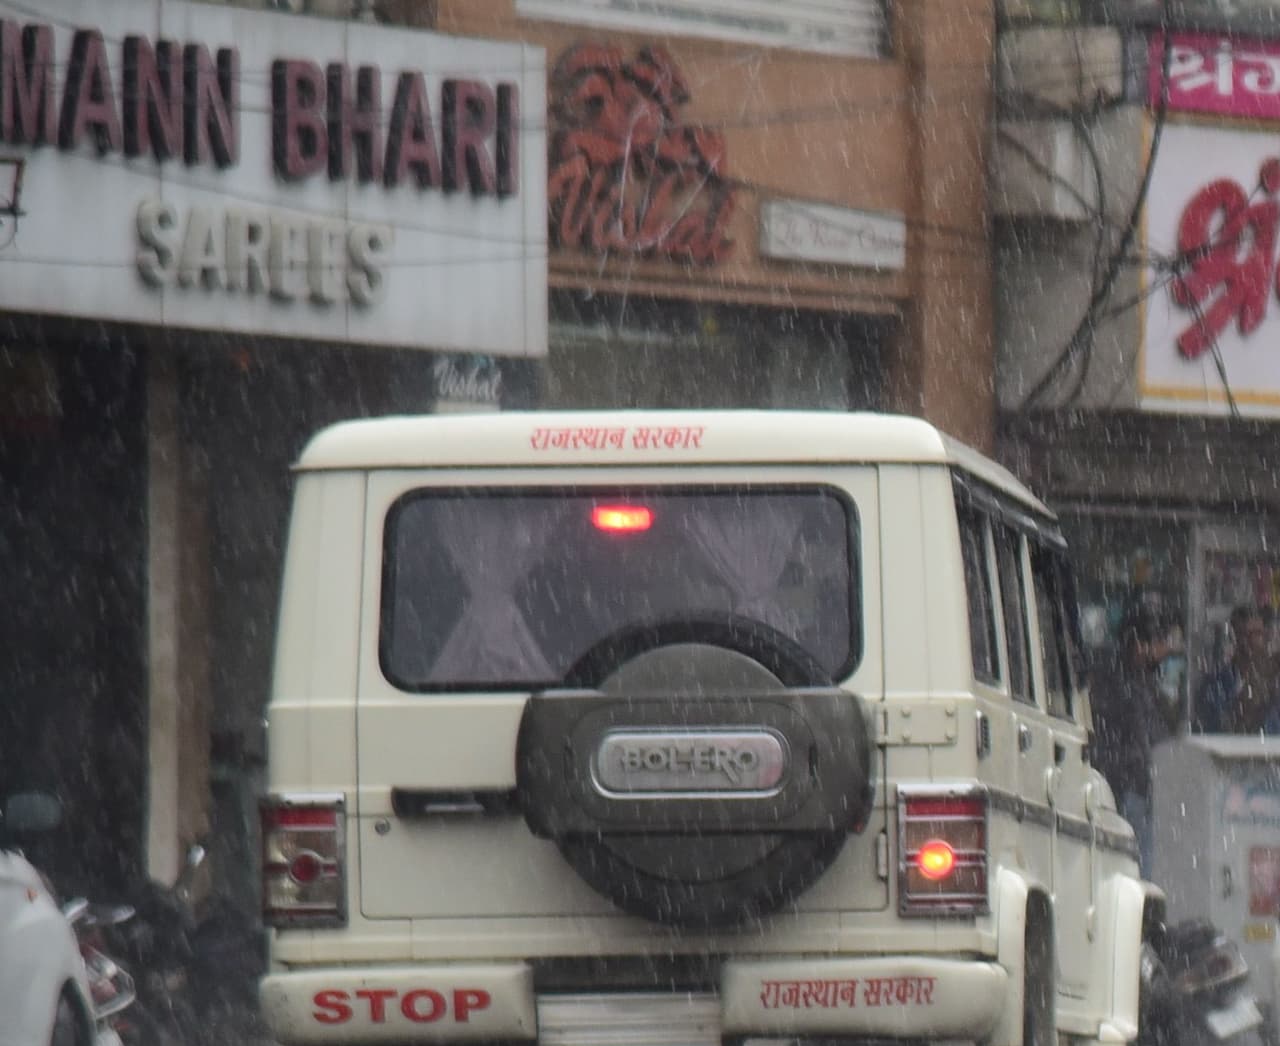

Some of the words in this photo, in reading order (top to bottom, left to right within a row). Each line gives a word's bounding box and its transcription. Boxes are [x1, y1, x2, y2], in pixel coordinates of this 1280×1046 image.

[0, 18, 241, 170] MANN
[271, 57, 519, 200] BHARI
[135, 199, 394, 306] SAREES
[530, 424, 626, 450] राजस्थान
[631, 423, 706, 449] सरकार
[620, 746, 760, 785] BOLERO
[312, 988, 492, 1025] STOP
[759, 979, 858, 1010] राजस्थान
[863, 976, 937, 1007] सरकार
